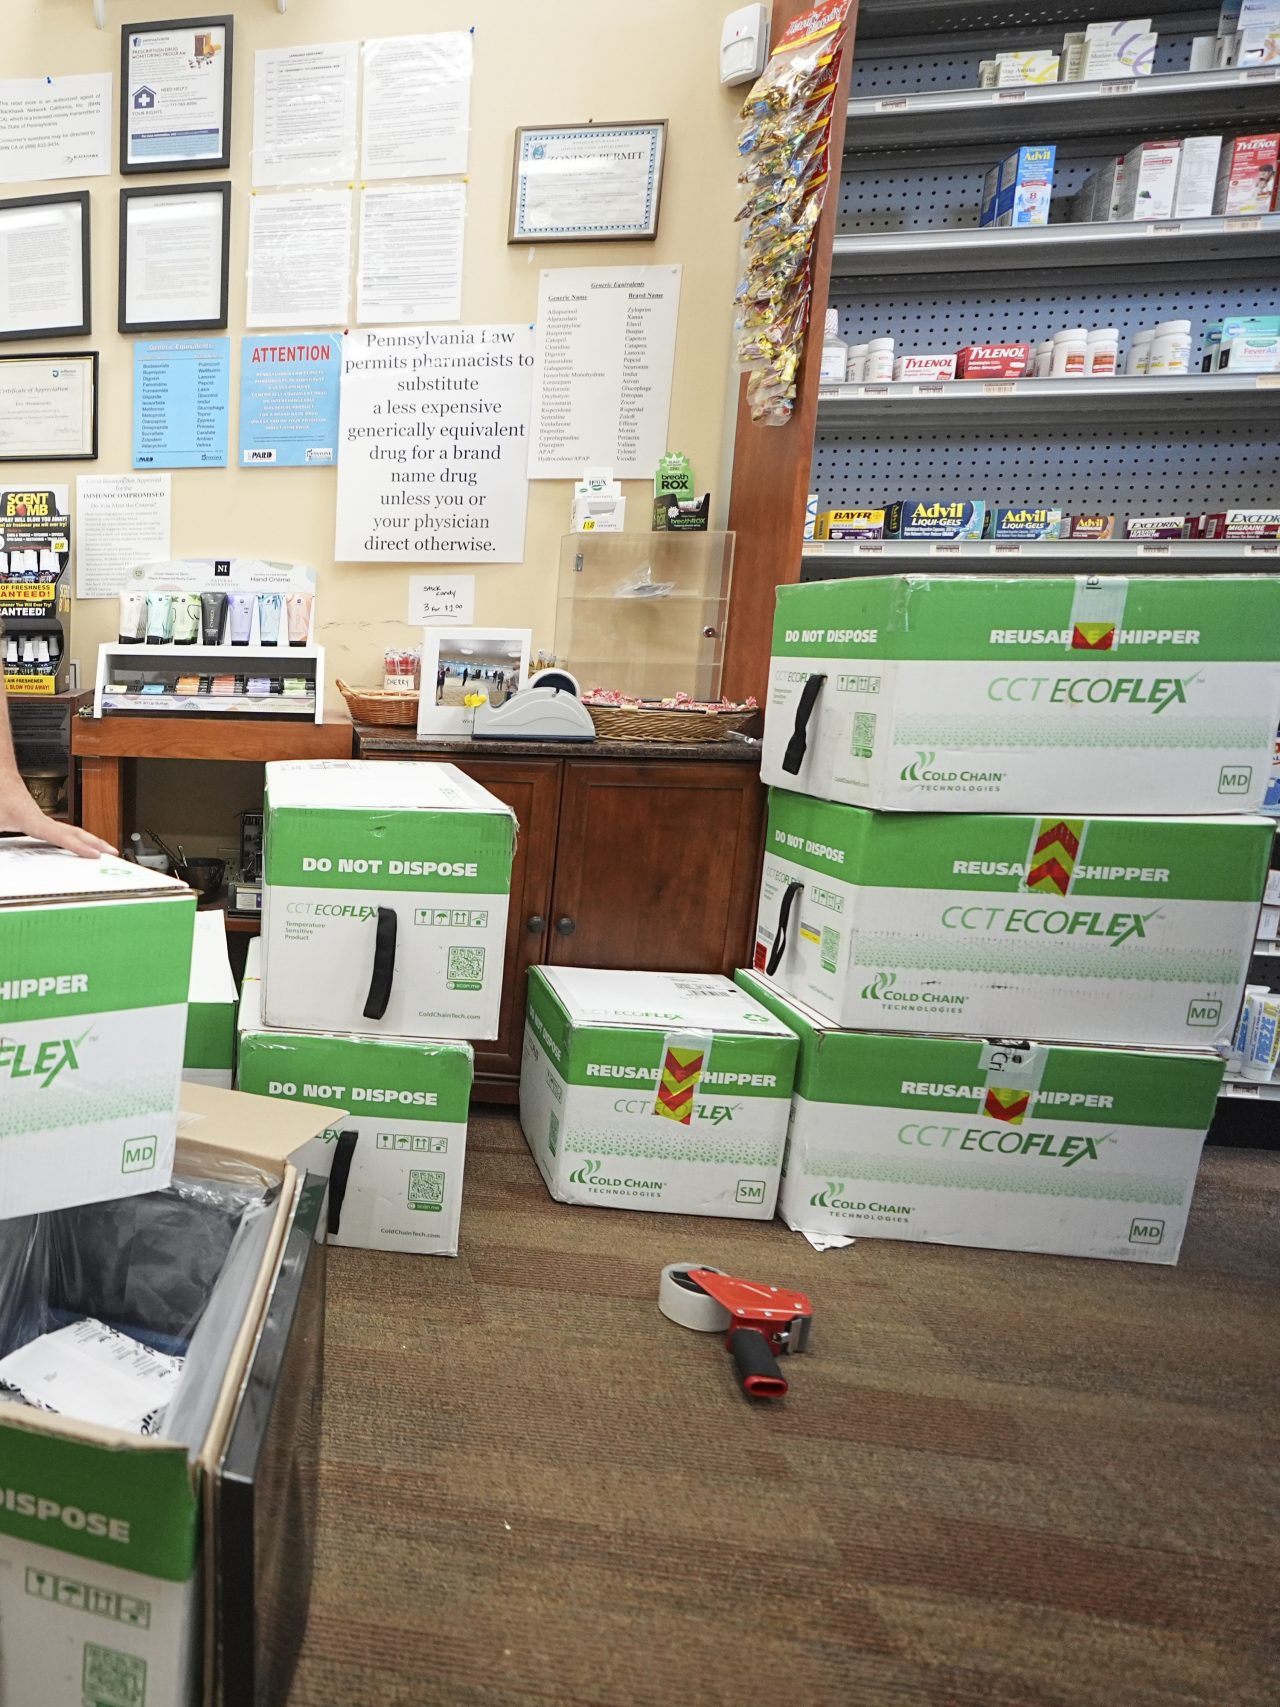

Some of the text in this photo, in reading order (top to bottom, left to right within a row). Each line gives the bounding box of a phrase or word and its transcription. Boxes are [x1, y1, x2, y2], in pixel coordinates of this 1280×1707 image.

[1236, 140, 1278, 150] TYLENOL
[1024, 151, 1050, 161] Advil
[367, 330, 515, 349] Pennsylvania Law
[252, 345, 330, 362] ATTENTION
[970, 347, 1024, 359] TYLENOL
[345, 352, 534, 373] permits pharmacists to
[905, 358, 953, 368] TYLENOL
[397, 377, 479, 391] substitute
[373, 399, 502, 417] a less expensive
[348, 422, 525, 441] generically equivalent
[370, 445, 501, 462] drug for a brand
[391, 468, 477, 486] name drug
[662, 481, 688, 489] ROX
[7, 493, 48, 504] SCENT
[381, 491, 487, 508] unless you or
[834, 512, 871, 520] BAYER
[912, 503, 964, 517] Advil
[1002, 510, 1046, 523] Advil
[372, 514, 489, 531] your physician
[912, 518, 962, 526] LIQUI-GELS
[1002, 521, 1046, 529] LIQUI-GELS
[1077, 518, 1103, 527] Advil
[1231, 513, 1280, 523] EXCEDR
[364, 536, 496, 551] direct otherwise.
[424, 603, 429, 611] 3
[785, 630, 878, 643] DO NOT DISPOSE
[987, 671, 1201, 713] CCT ECOFLEX
[923, 770, 1003, 782] COLD CHAIN
[1223, 773, 1248, 787] MD
[775, 830, 845, 863] DO NOT DISPOSE
[302, 858, 478, 877] DO NOT DISPOSE
[953, 861, 1170, 883] REUSA SHIPPER
[287, 902, 378, 922] CCT ECOFLEX
[941, 906, 1163, 947] CCT ECOFLEX
[884, 991, 965, 1004] COLD CHAIN
[419, 1011, 480, 1020] ColdChainTech.com
[615, 1010, 683, 1019] ECOFLEX
[882, 1004, 963, 1013] TECHNOLOGIES
[1191, 1007, 1217, 1021] MD
[269, 1081, 438, 1105] DO NOT DISPOSE
[1031, 1090, 1114, 1108] HIPPER
[614, 1099, 647, 1114] CCT
[898, 1124, 1115, 1167] CCT ECOFLEX
[125, 1144, 153, 1163] MD
[590, 1176, 663, 1189] COLD CHAIN
[589, 1188, 661, 1197] TECHNOLOGIES
[740, 1187, 761, 1197] SM
[832, 1199, 911, 1214] COLD CHAIN
[830, 1212, 908, 1223] TECHNOLOGIES
[381, 1228, 440, 1238] ColdChainTech.com
[1133, 1225, 1160, 1238] MD
